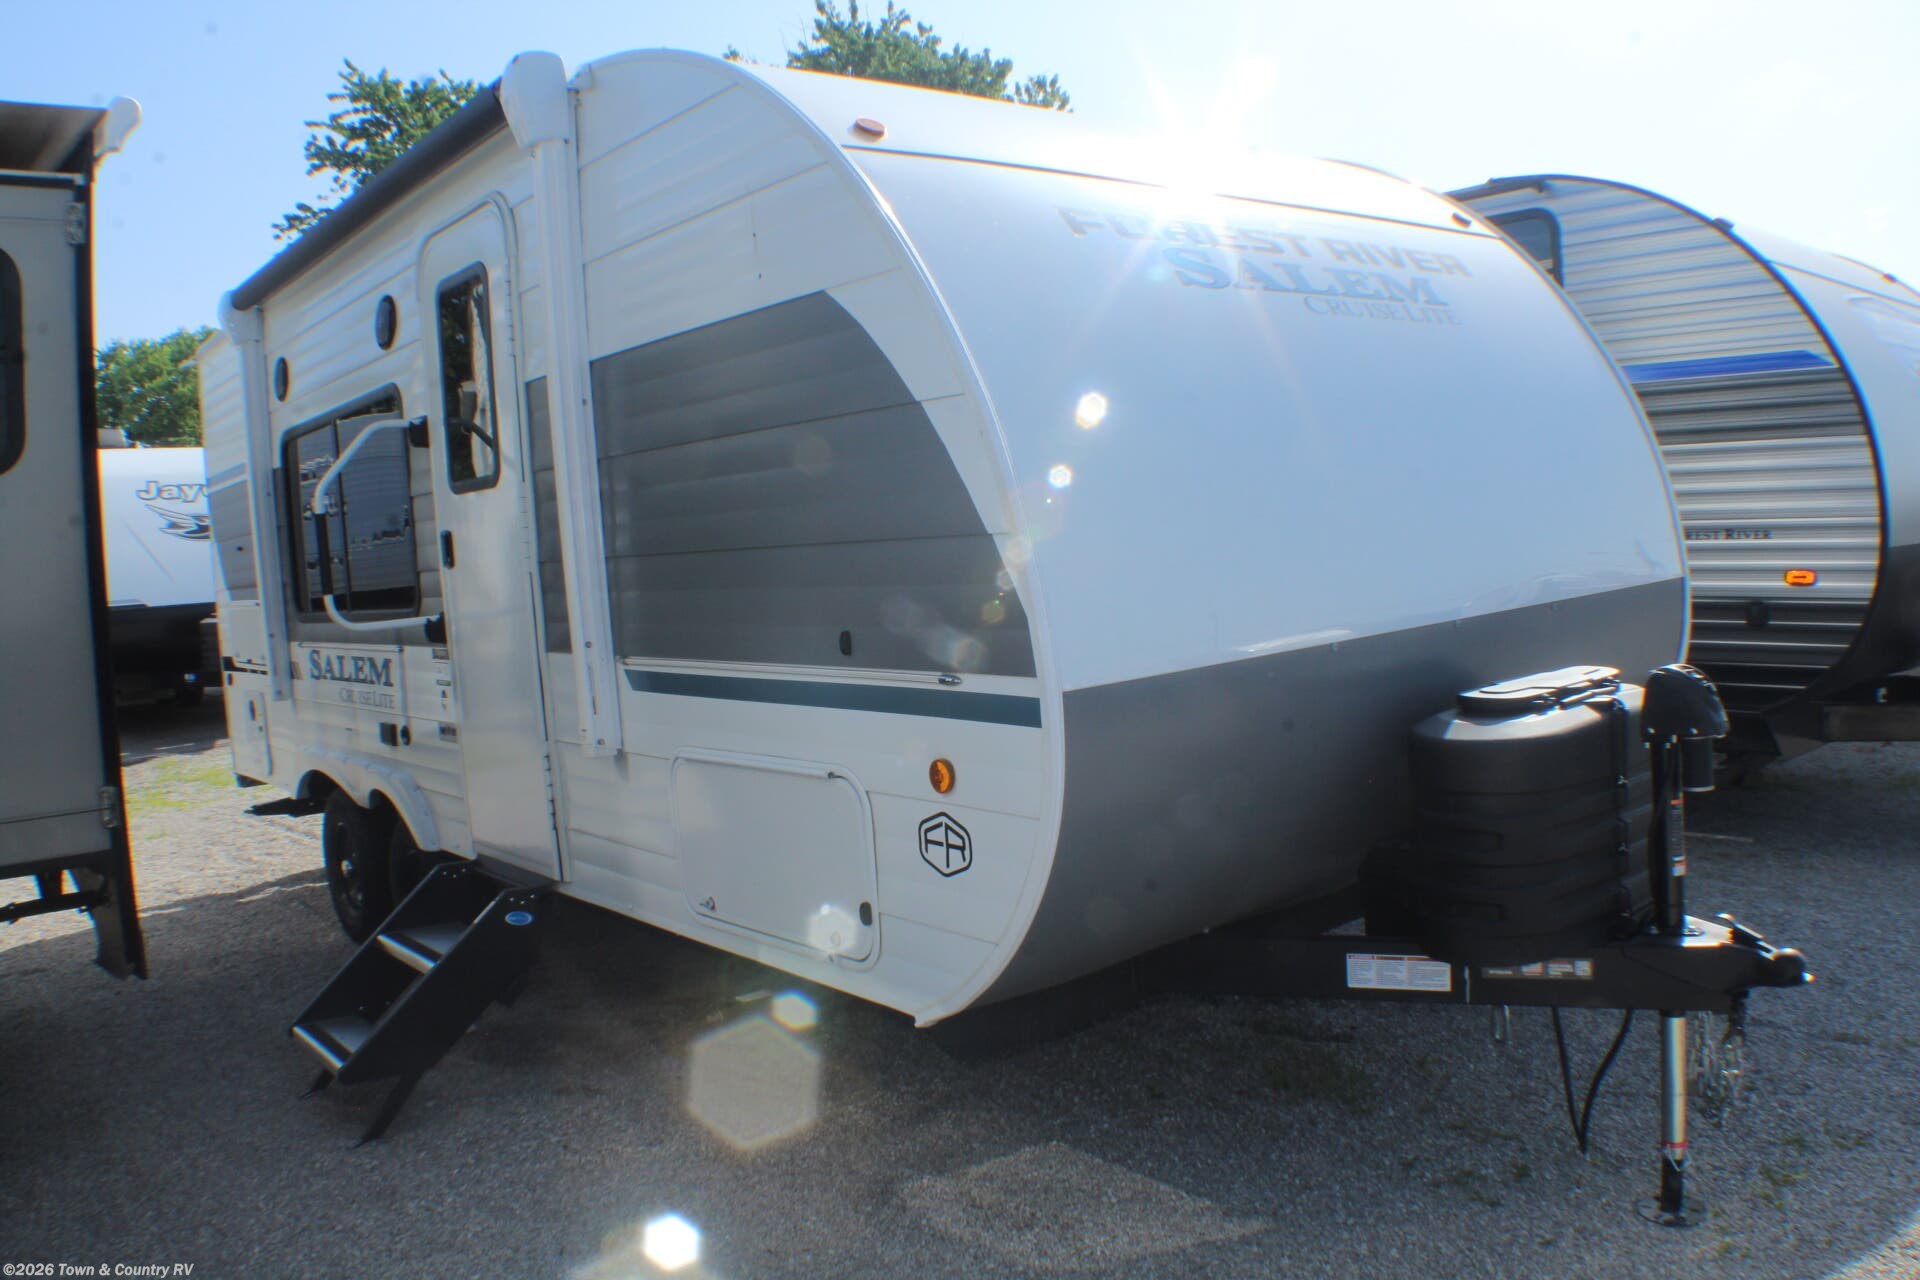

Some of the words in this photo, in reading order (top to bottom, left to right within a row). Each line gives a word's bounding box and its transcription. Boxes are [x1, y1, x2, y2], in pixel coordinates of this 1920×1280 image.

[1161, 248, 1449, 307] SALEM
[1319, 237, 1473, 279] RIVER
[308, 649, 394, 687] SALEM
